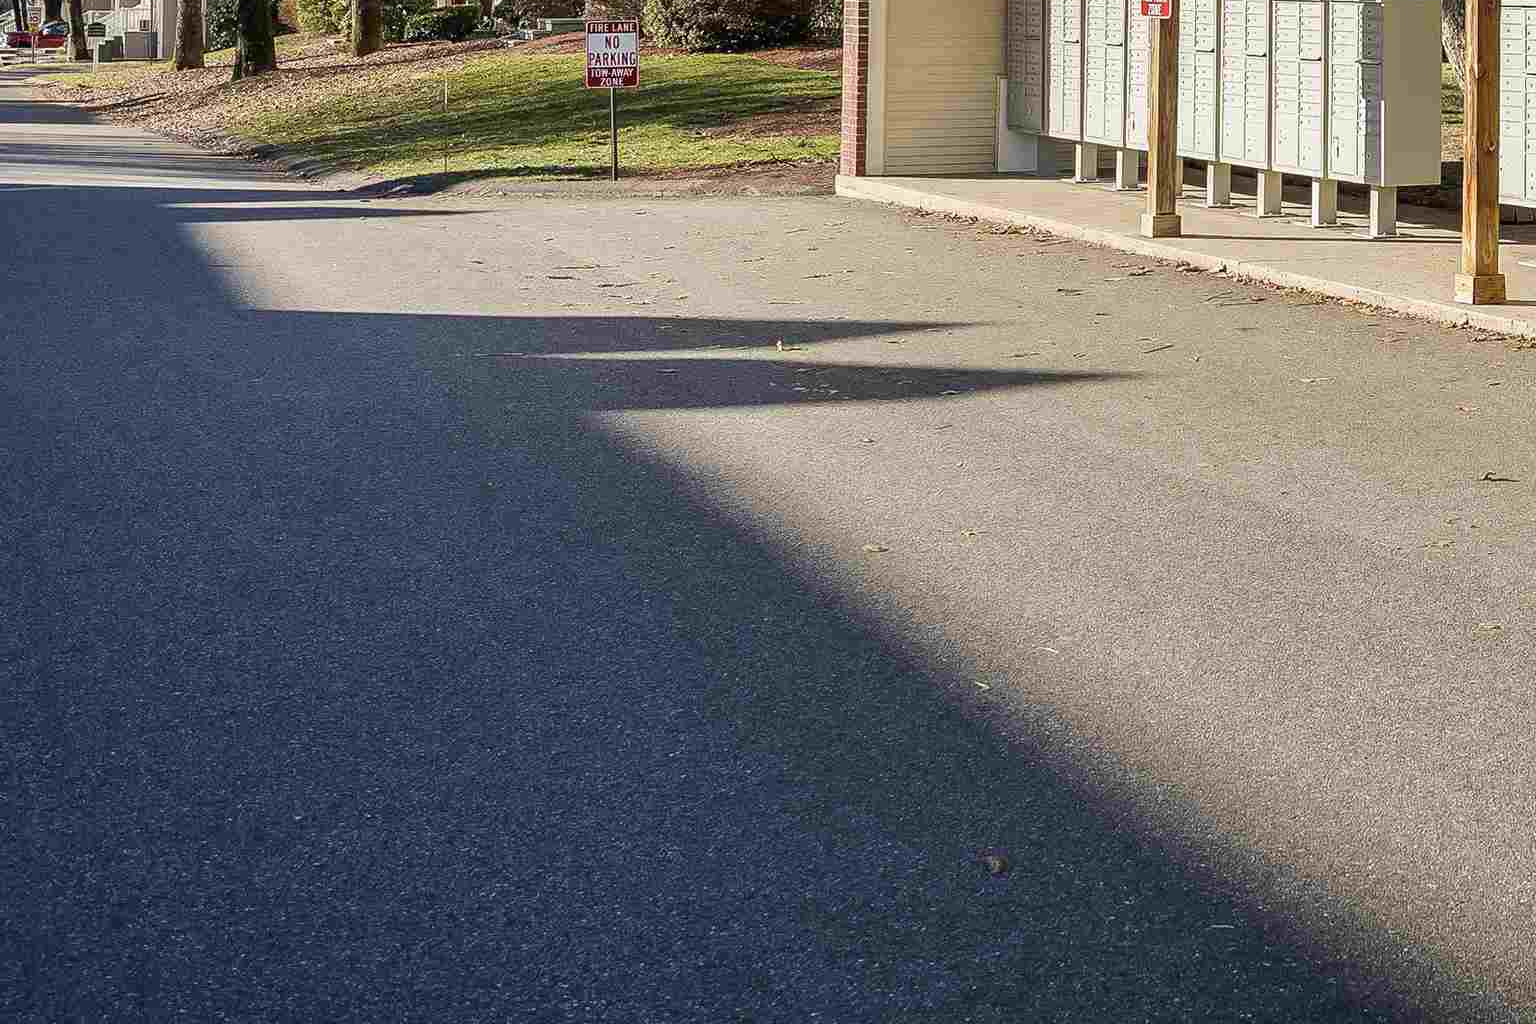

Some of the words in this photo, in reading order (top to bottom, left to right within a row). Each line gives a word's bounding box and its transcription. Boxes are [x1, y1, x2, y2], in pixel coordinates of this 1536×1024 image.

[590, 23, 609, 32] FIRE
[612, 23, 635, 32] LANE
[605, 35, 620, 49] NO
[589, 52, 636, 66] PARKING
[591, 68, 634, 78] TOW-AWAY
[600, 77, 624, 86] ZONE
